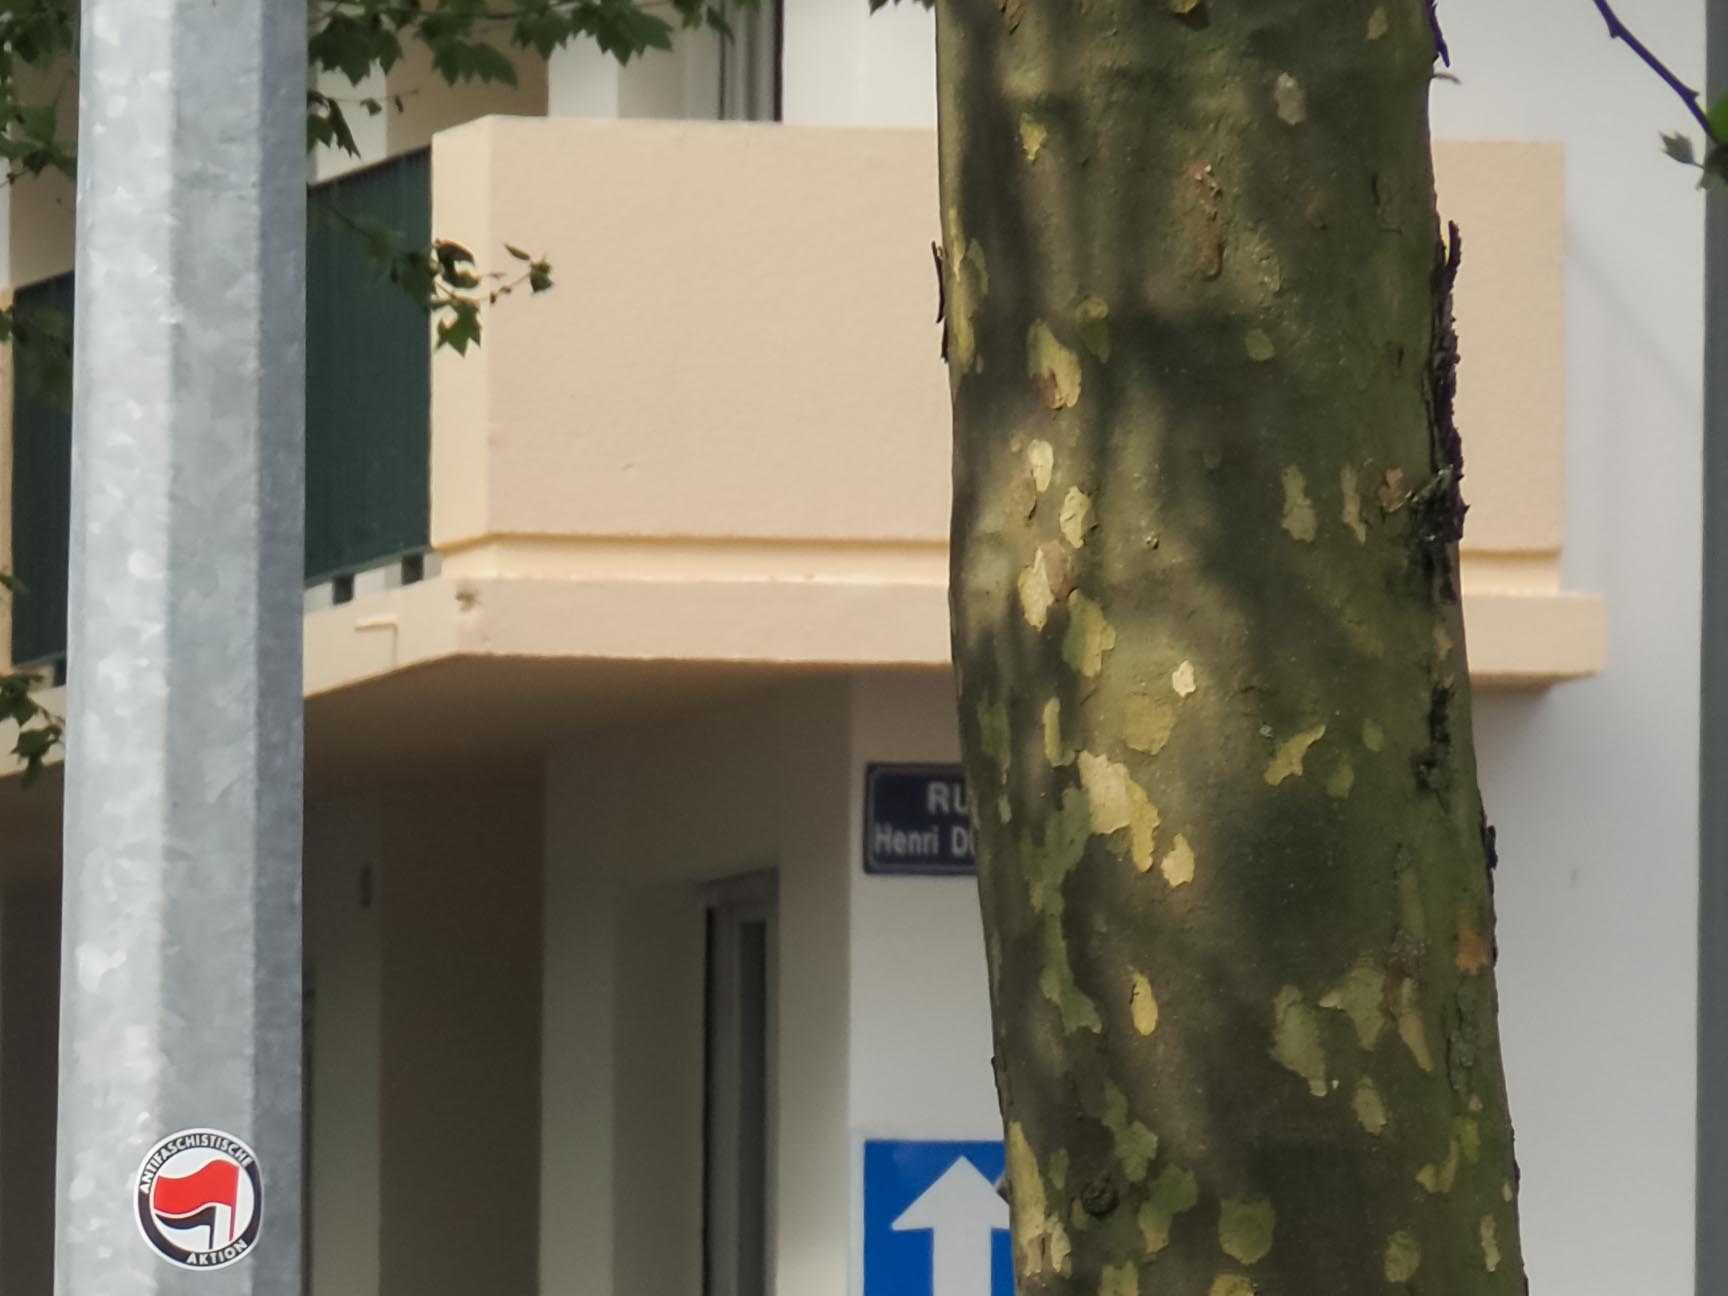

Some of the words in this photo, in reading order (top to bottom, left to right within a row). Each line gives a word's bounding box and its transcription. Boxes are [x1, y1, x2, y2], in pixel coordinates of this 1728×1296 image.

[875, 824, 939, 855] Henri
[140, 1134, 253, 1194] ANTIFASCHISTISCHE
[186, 1239, 248, 1265] AKTION
